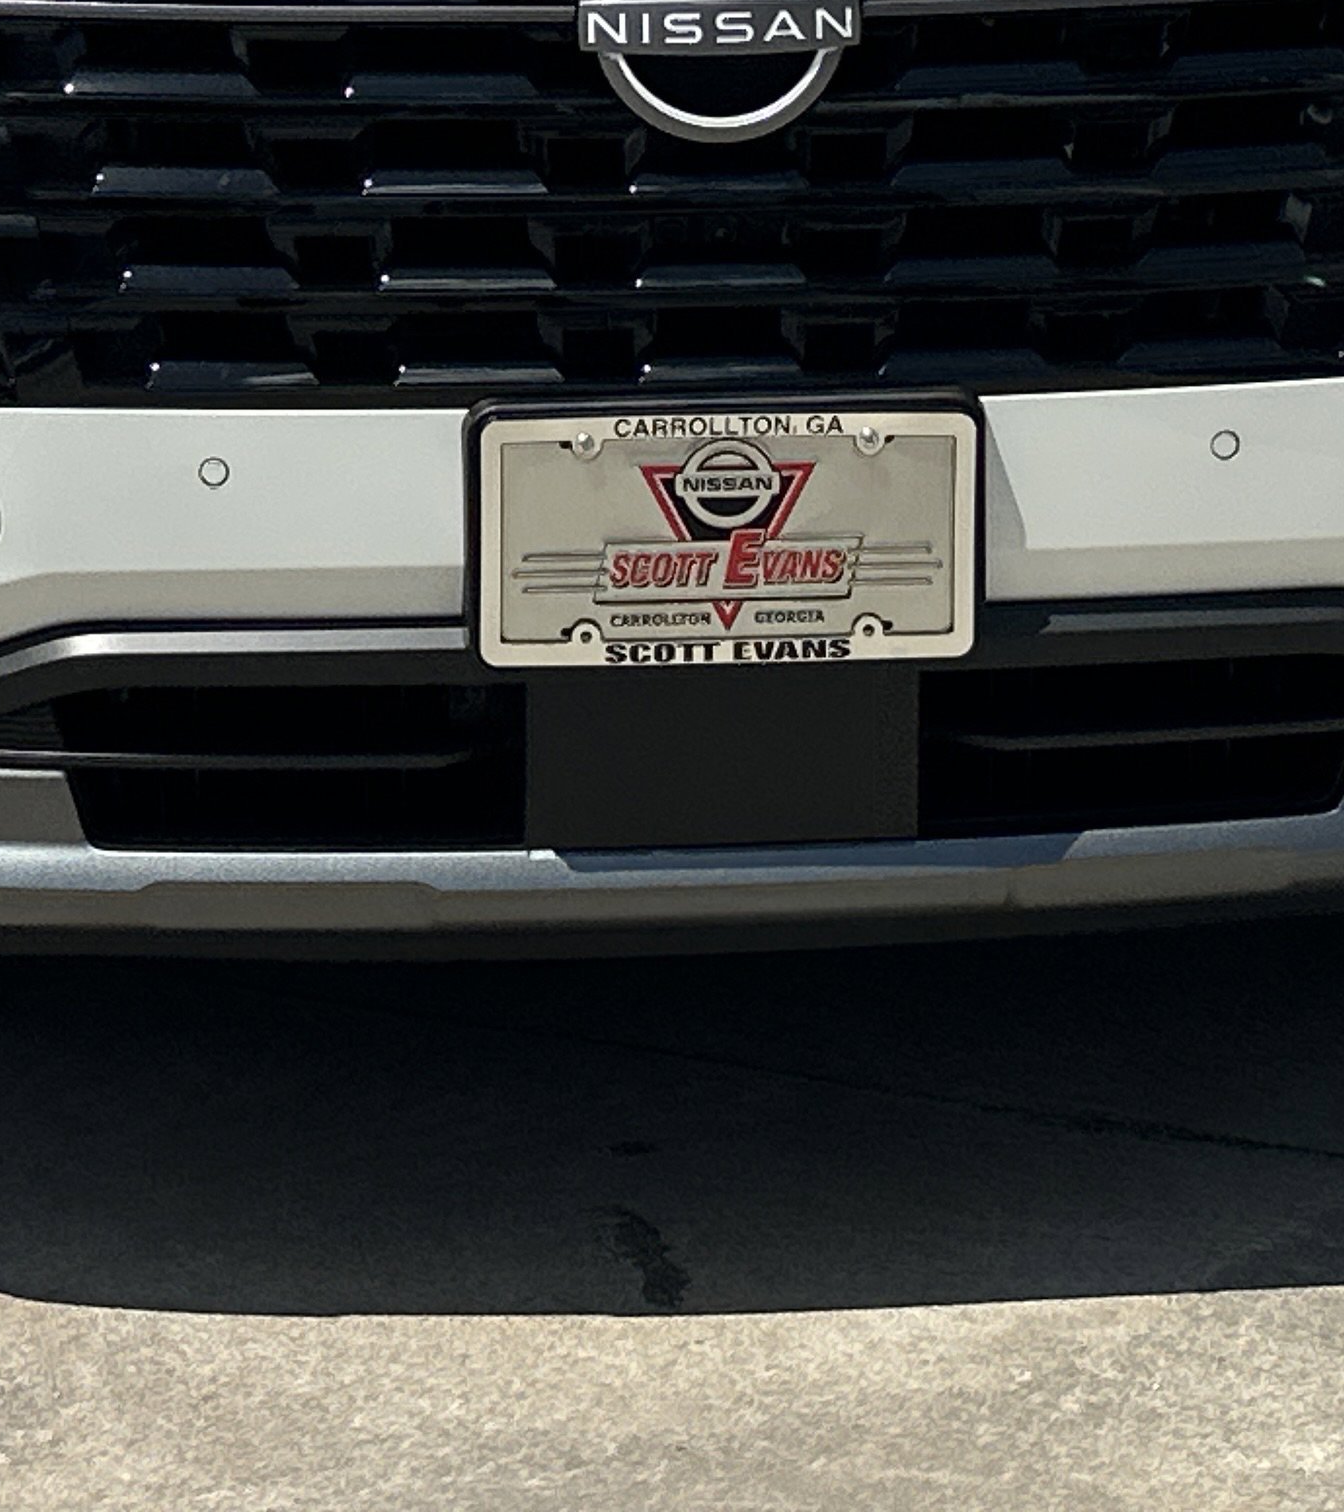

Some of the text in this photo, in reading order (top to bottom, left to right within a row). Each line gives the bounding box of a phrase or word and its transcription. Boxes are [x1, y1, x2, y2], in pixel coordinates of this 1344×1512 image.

[587, 7, 853, 44] NISSAN
[805, 415, 845, 435] GA
[682, 476, 774, 493] NISSAN
[609, 529, 847, 589] SCOTT EVANS
[754, 609, 825, 624] GEORGIA
[605, 638, 852, 664] SCOTT EVANS
